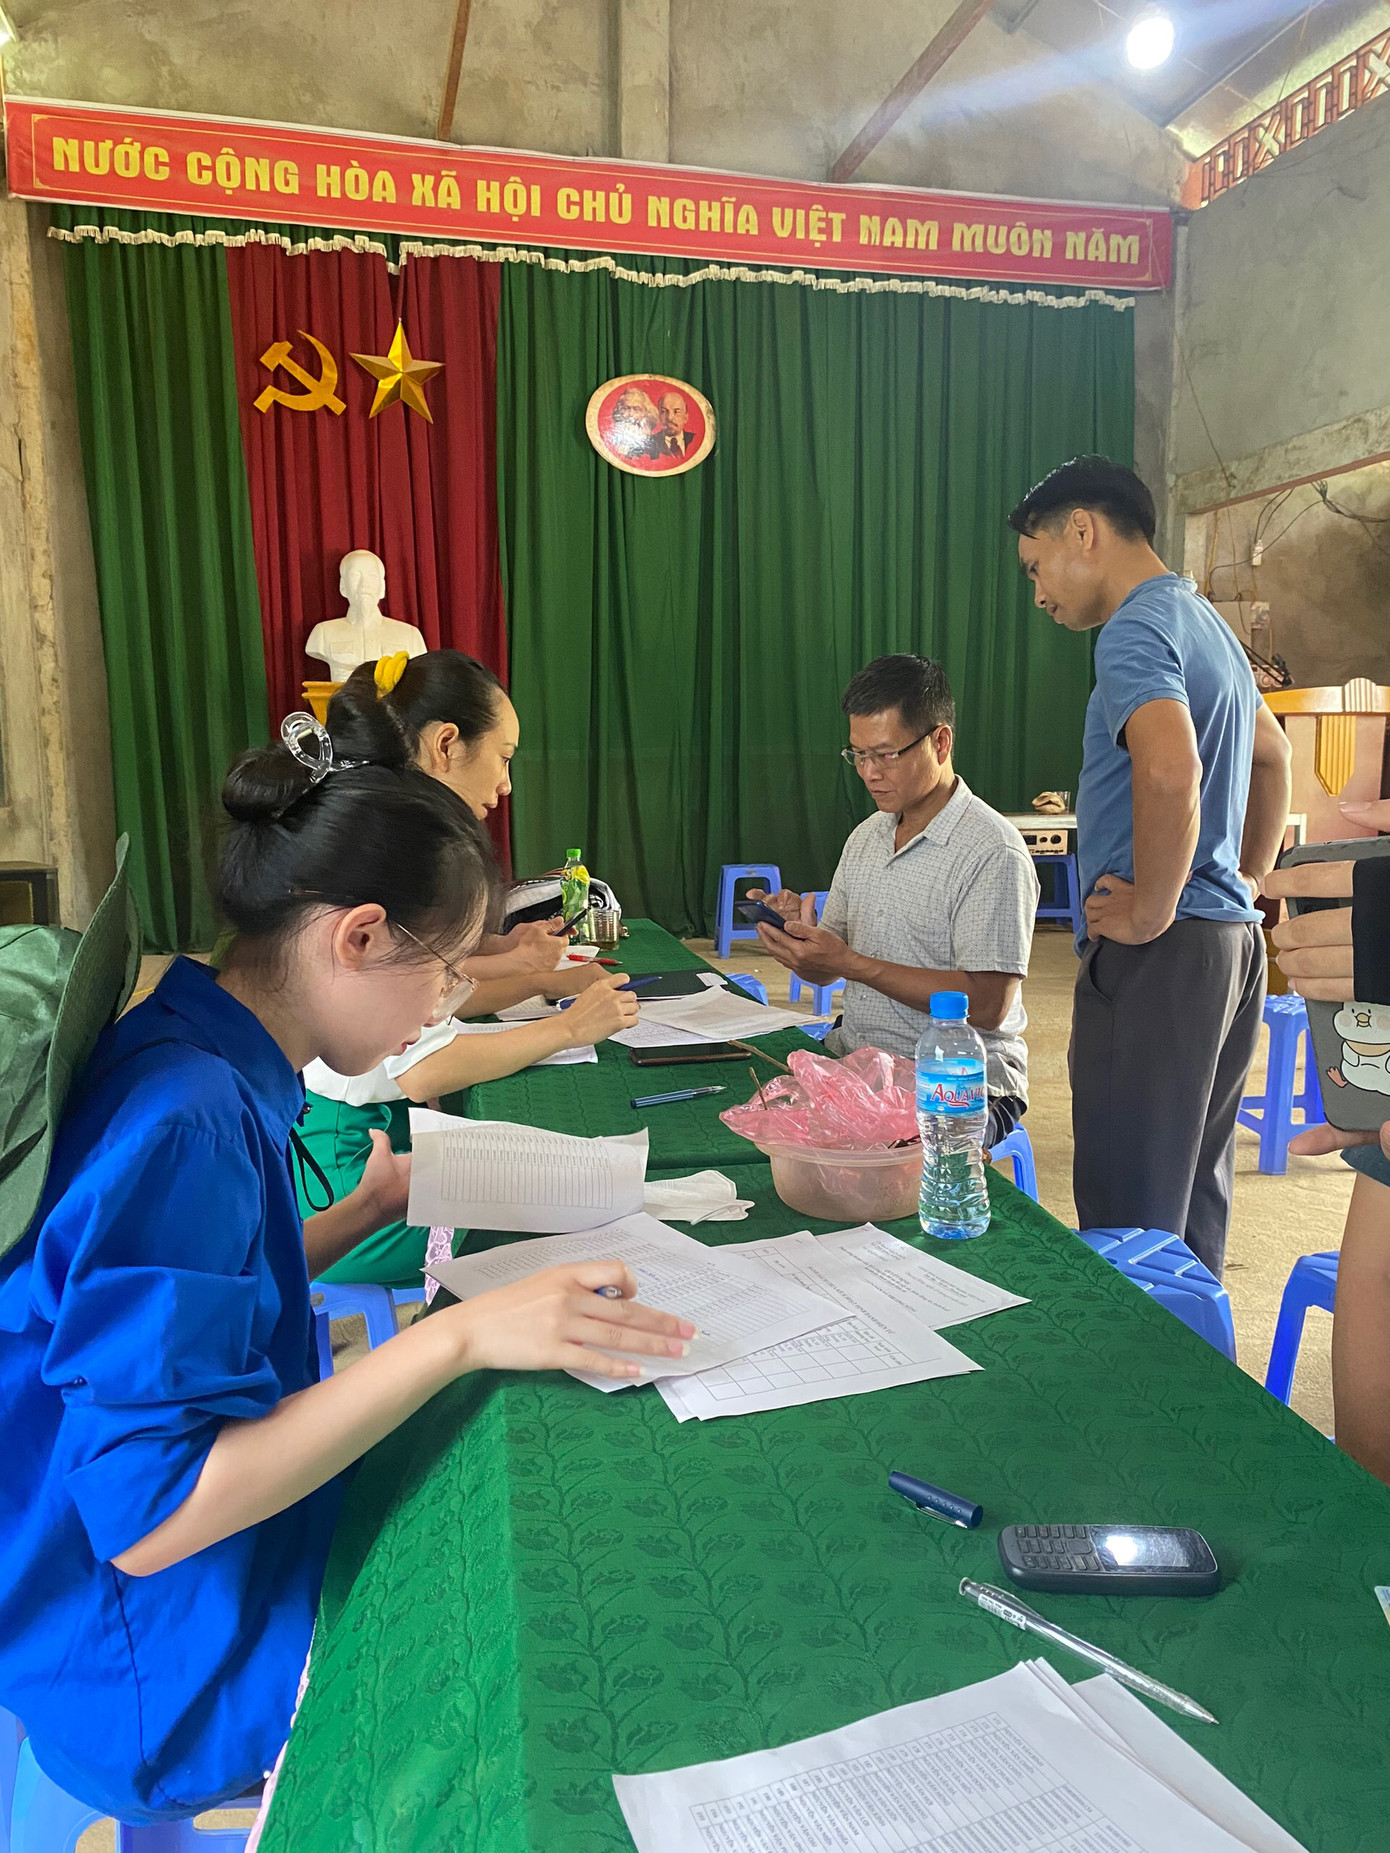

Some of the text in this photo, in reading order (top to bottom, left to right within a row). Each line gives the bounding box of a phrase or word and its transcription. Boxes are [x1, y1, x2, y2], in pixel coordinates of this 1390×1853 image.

[52, 136, 1140, 265] NƯỚC CỘNG HÒA XÃ HỘI CHỦ NGHĨA VIỆT NAM MUÔN NĂM
